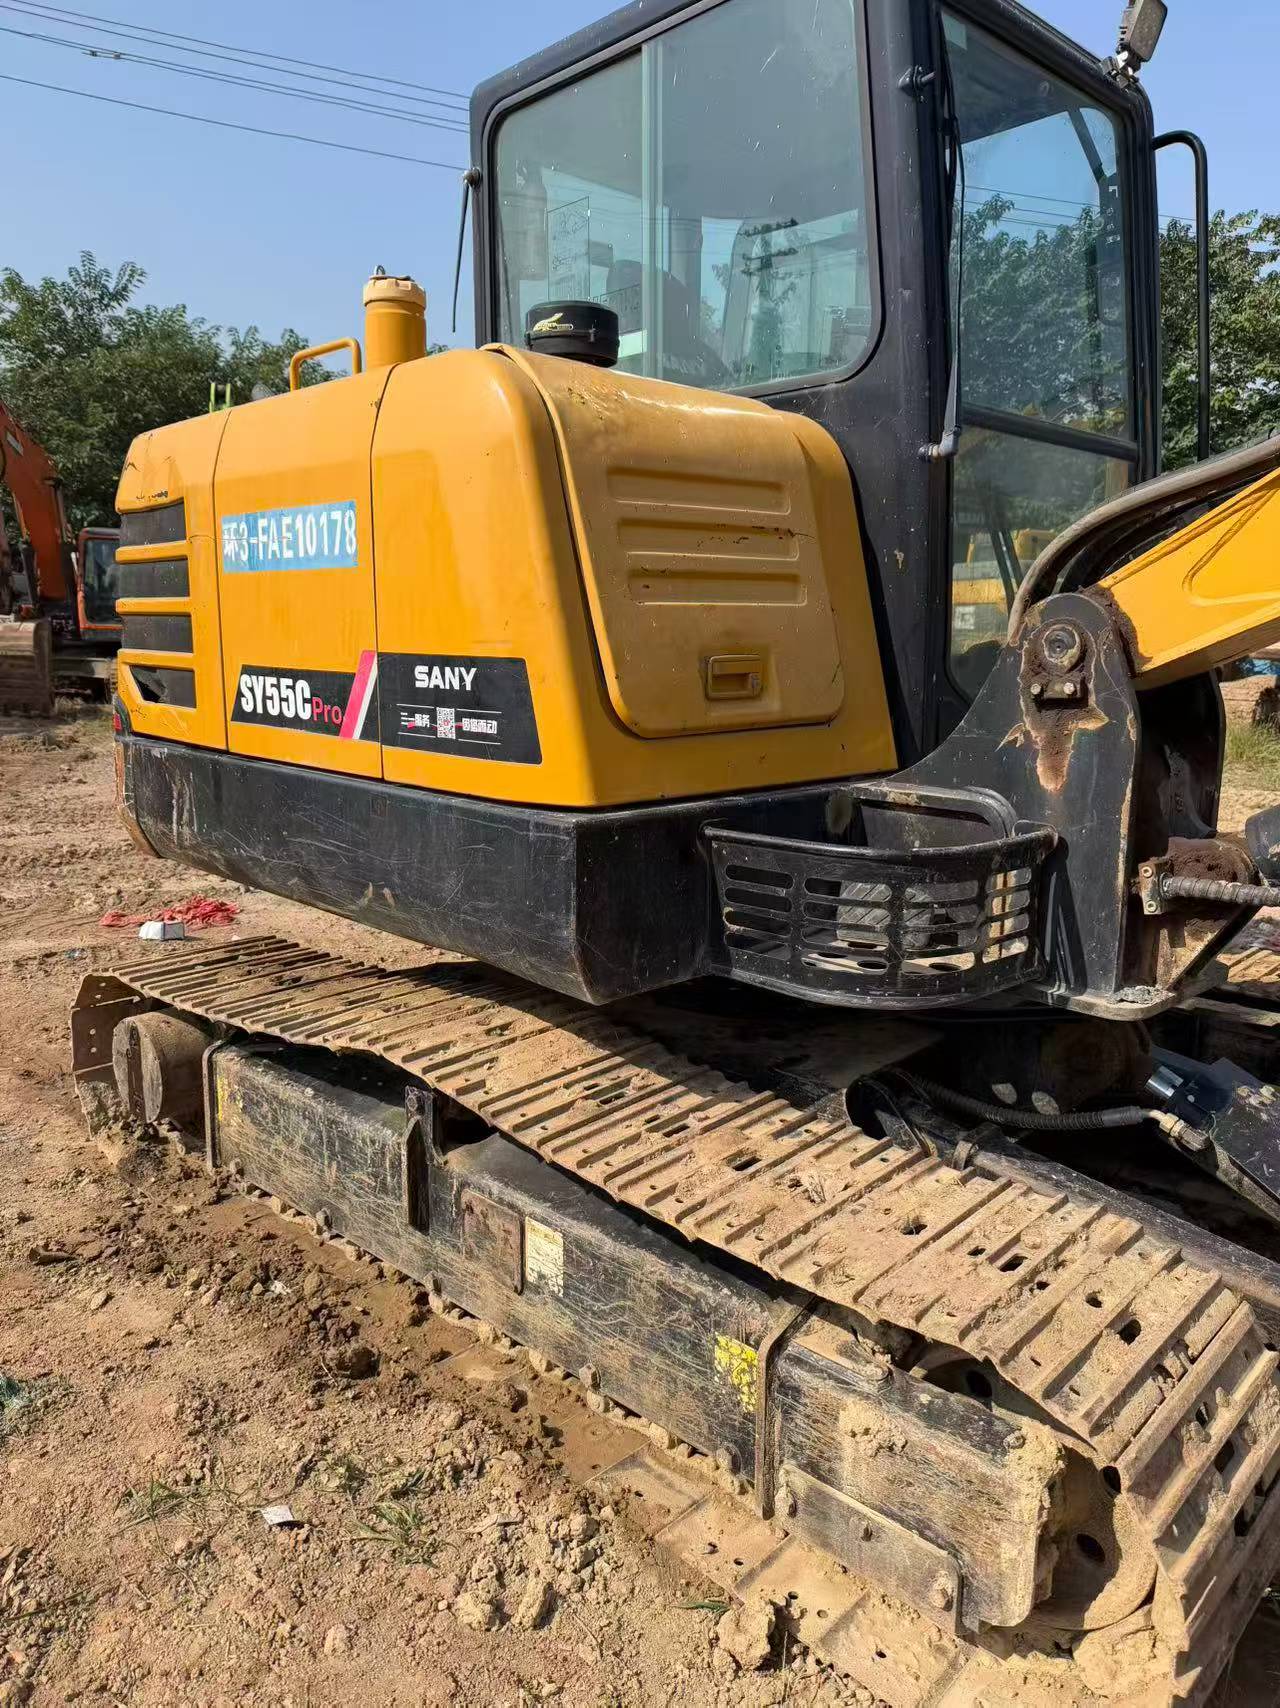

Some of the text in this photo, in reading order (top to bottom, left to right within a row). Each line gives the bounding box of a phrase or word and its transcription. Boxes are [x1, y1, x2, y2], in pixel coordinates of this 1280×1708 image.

[414, 665, 477, 691] SANY
[240, 674, 343, 725] SY55C Pro
